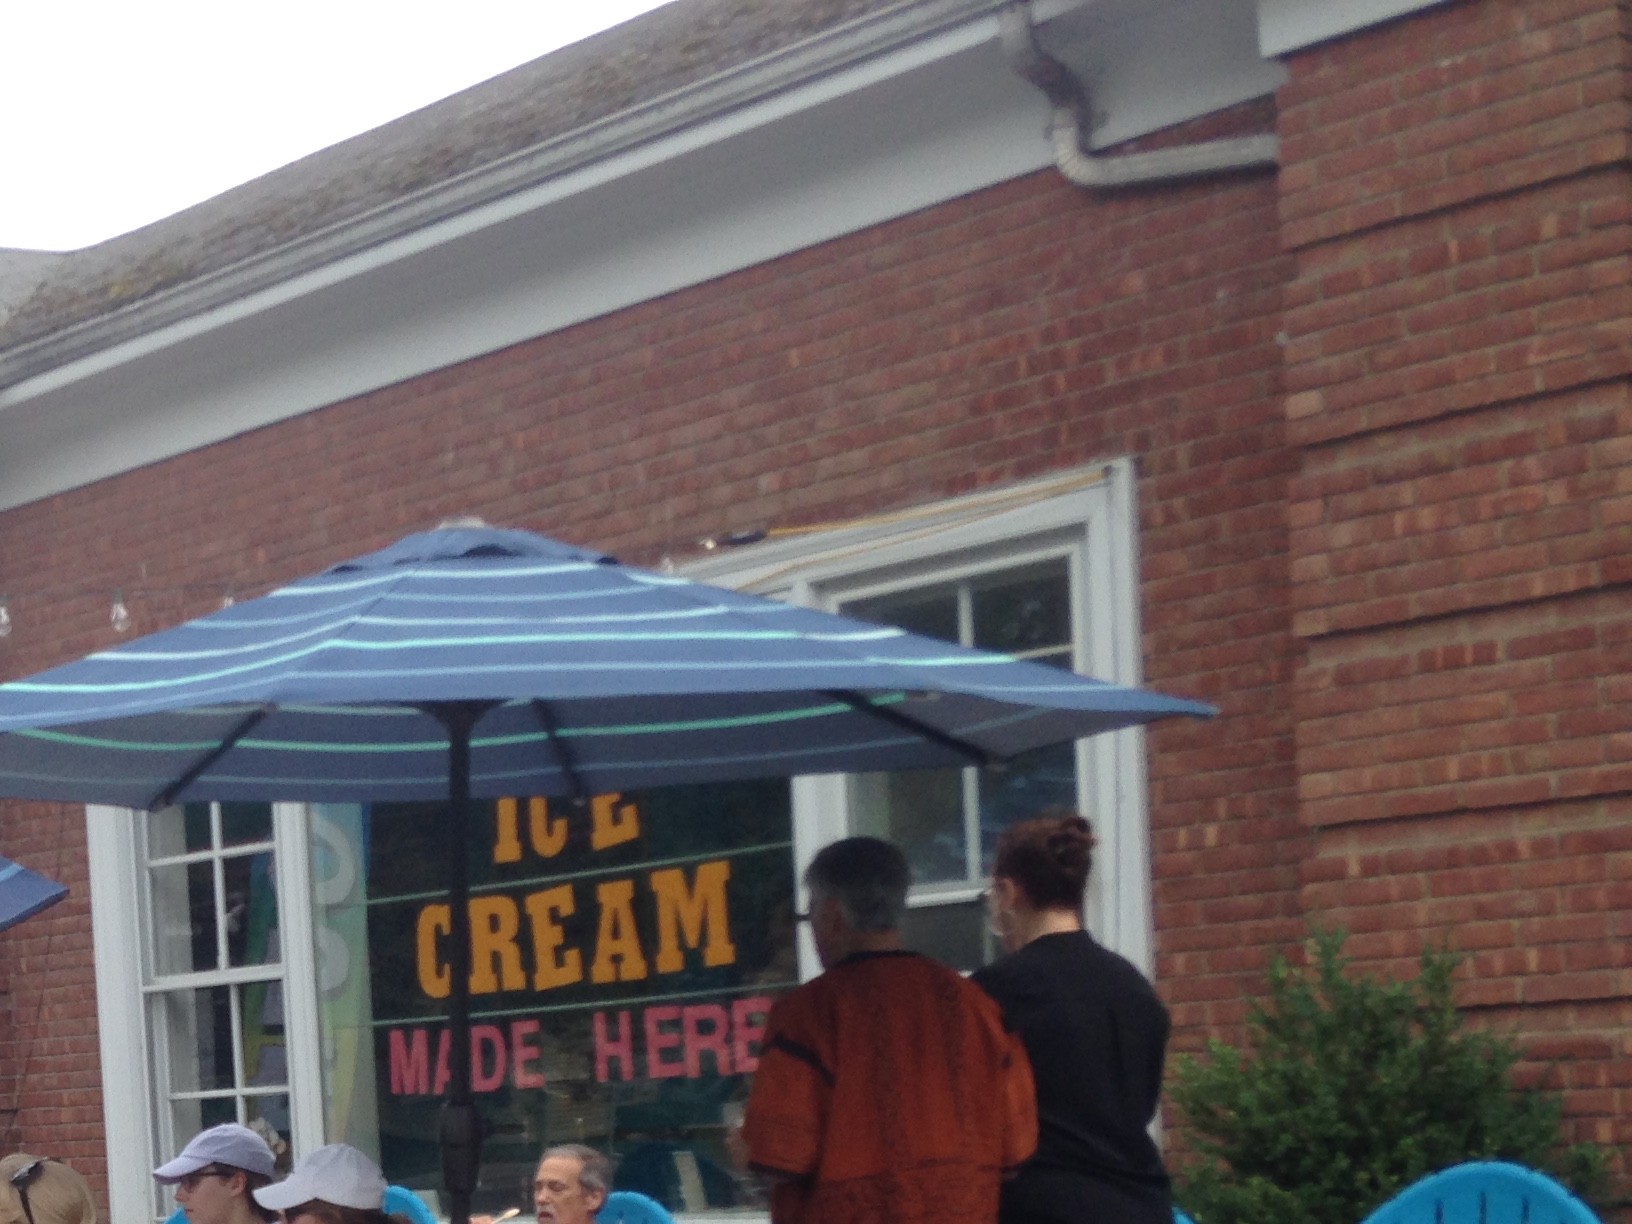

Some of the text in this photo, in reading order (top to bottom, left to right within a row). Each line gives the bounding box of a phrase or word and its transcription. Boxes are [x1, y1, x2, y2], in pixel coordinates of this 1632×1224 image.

[494, 792, 640, 864] ICE
[416, 860, 736, 999] CREAM
[593, 997, 773, 1083] HERE
